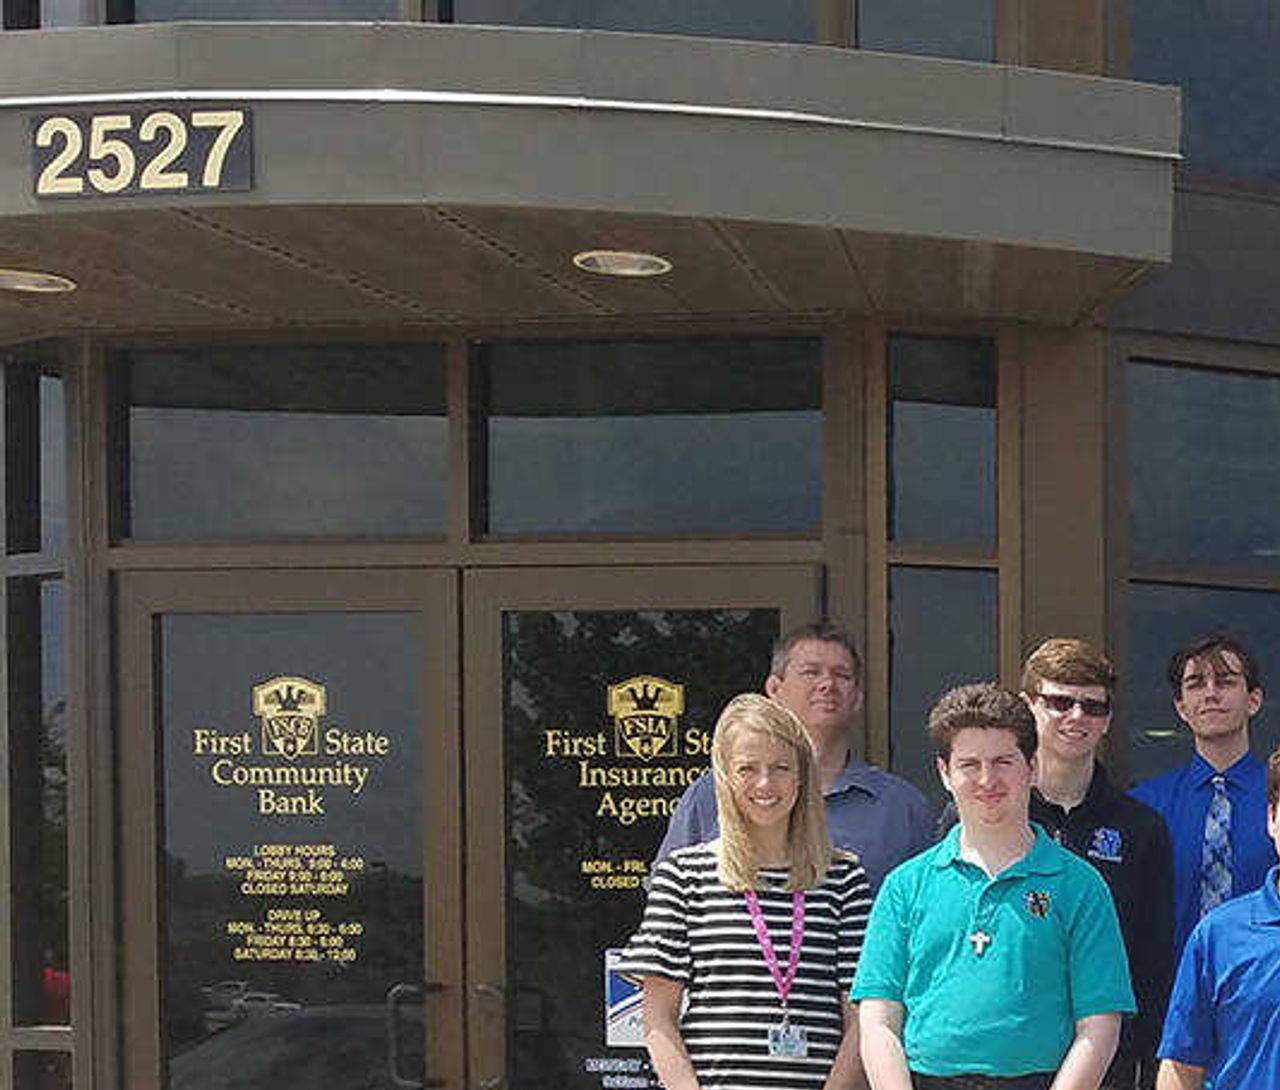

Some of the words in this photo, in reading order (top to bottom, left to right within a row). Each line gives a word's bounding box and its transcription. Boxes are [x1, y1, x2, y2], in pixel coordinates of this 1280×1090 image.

[36, 110, 244, 193] 2527
[624, 717, 667, 736] FSIA
[193, 729, 252, 755] First
[325, 729, 389, 755] State
[545, 730, 606, 757] First
[212, 759, 369, 793] Community
[257, 789, 324, 815] Bank
[247, 871, 286, 882] FRIDAY
[591, 876, 640, 889] CLOSED
[240, 883, 287, 895] CLOSED
[290, 883, 350, 895] SATURDAY
[304, 910, 320, 921] UP
[247, 936, 286, 947] FRIDAY
[233, 948, 292, 960] SATURDAY
